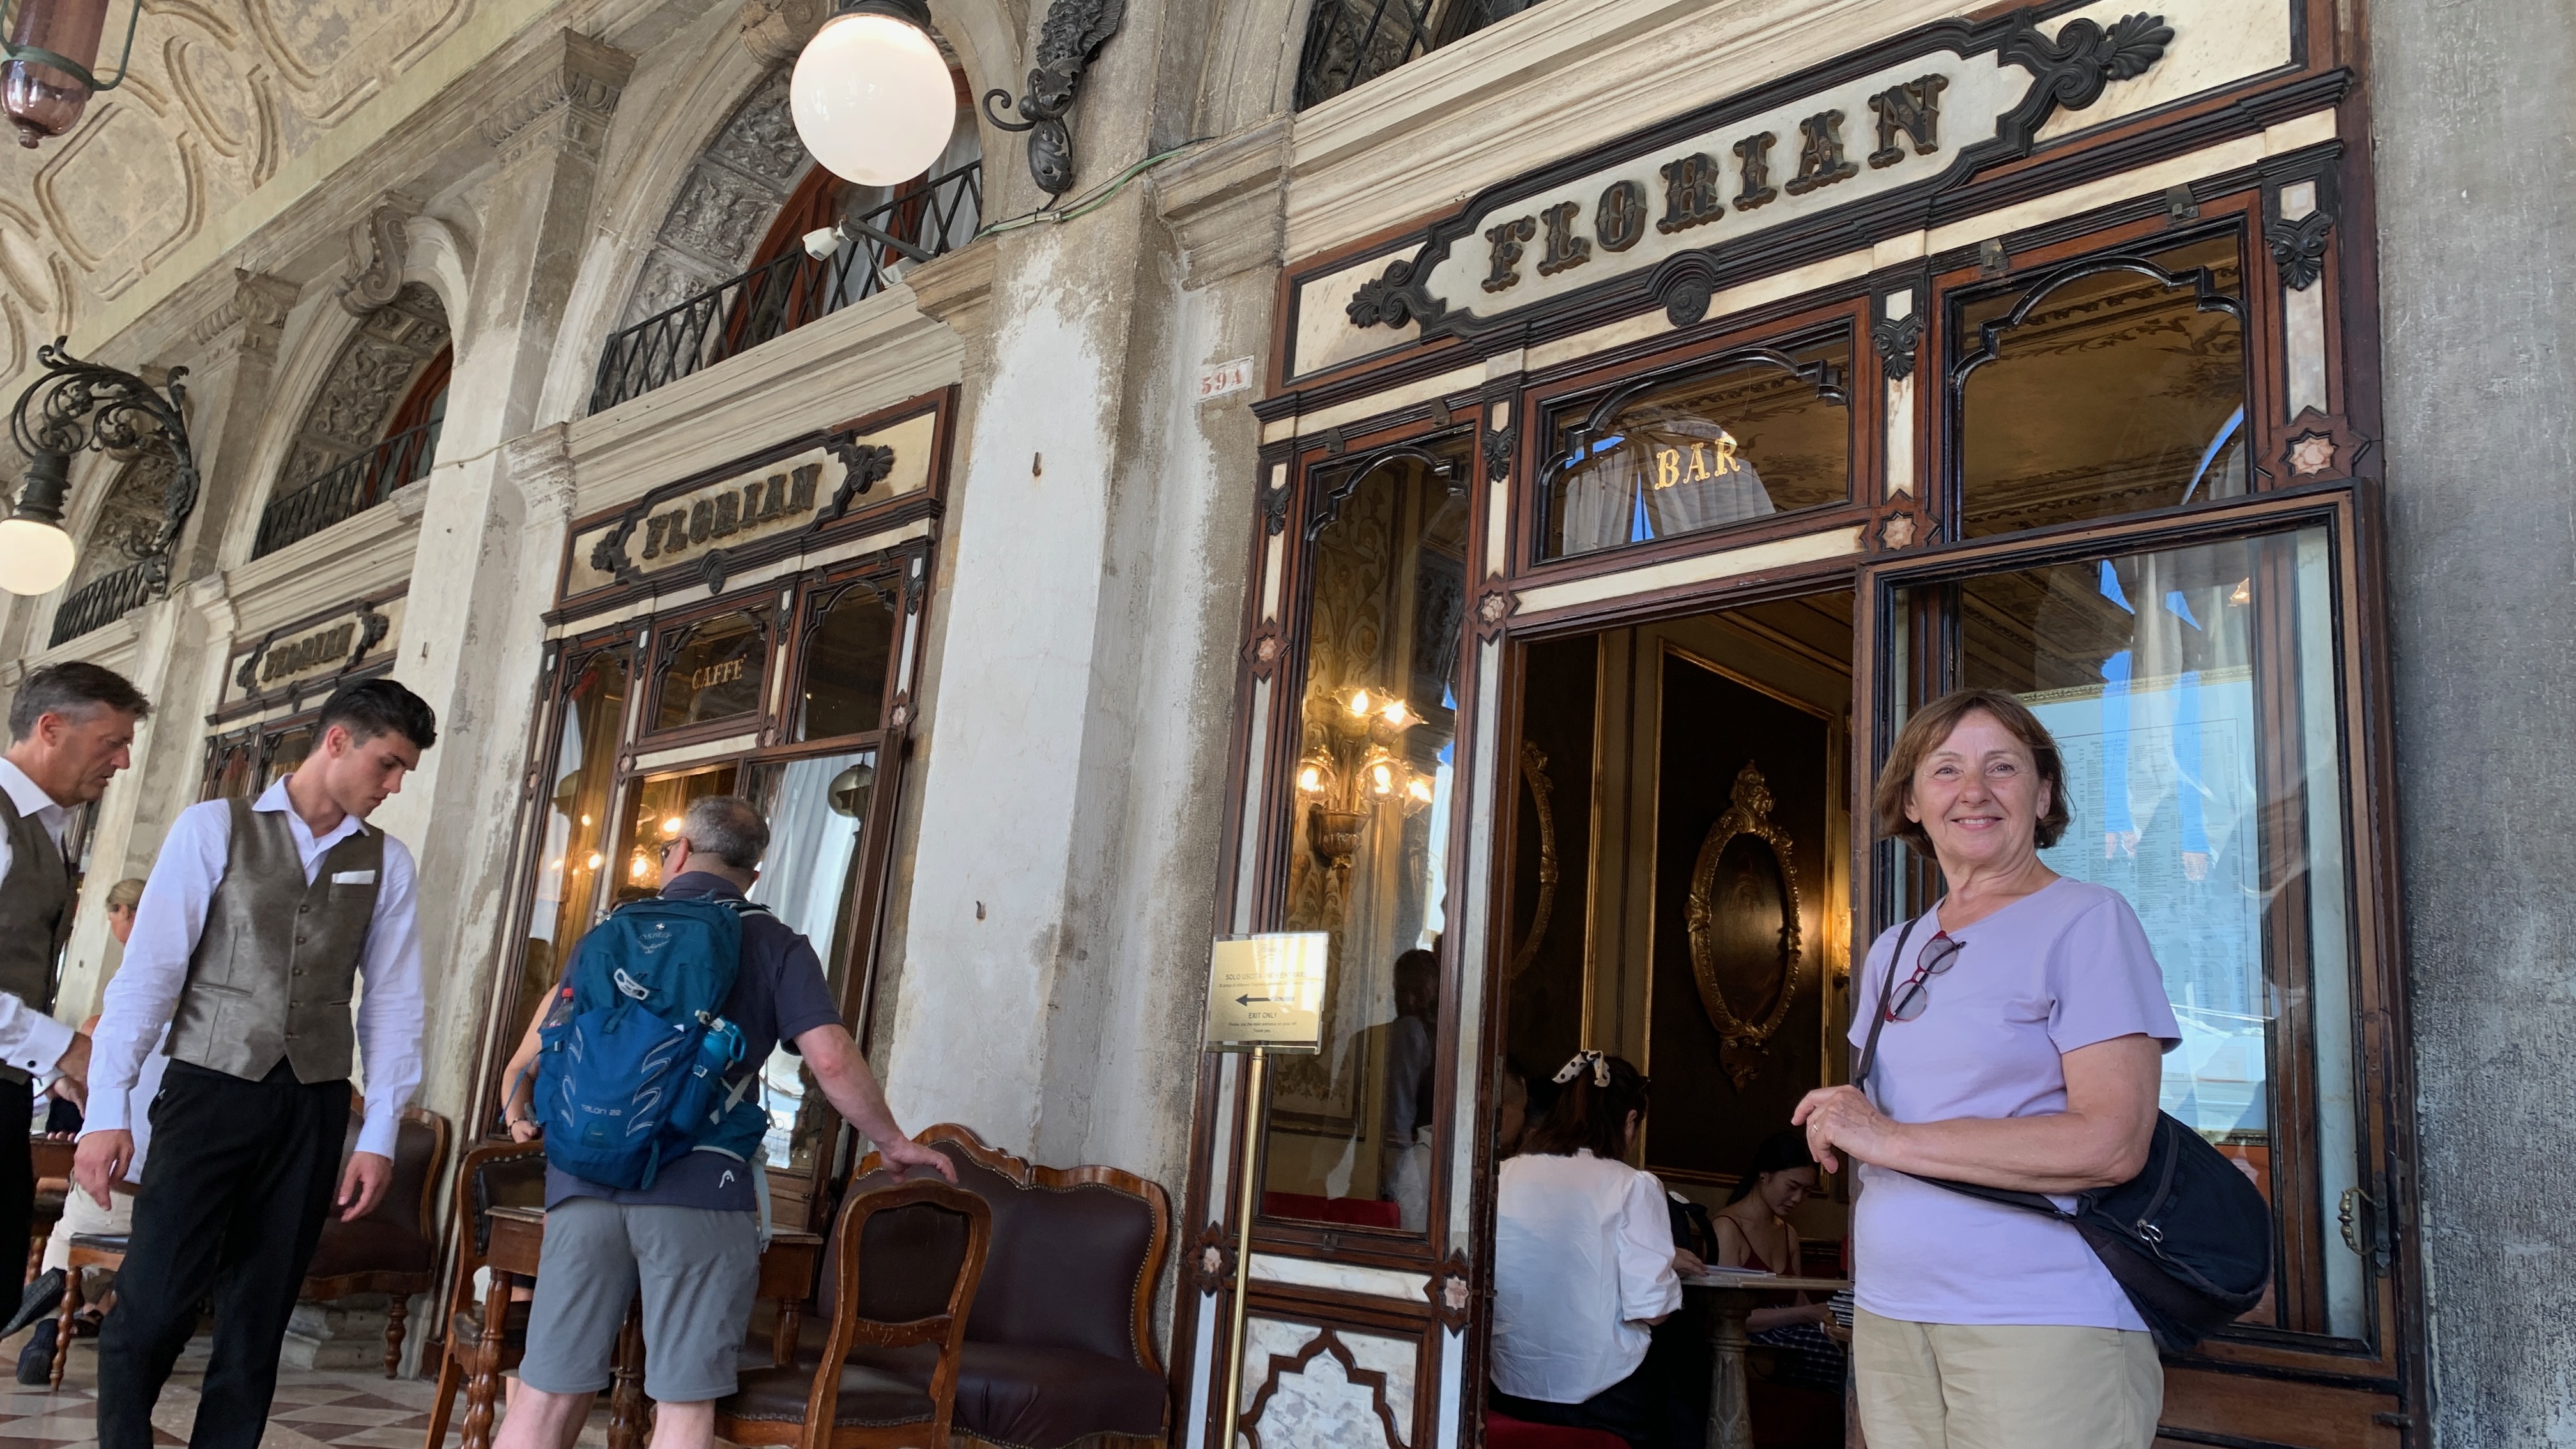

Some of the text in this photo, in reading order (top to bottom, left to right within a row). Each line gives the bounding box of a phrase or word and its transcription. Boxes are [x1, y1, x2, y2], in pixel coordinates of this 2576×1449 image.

[1481, 73, 1949, 294] FLORIAN
[1201, 368, 1243, 395] 59A
[1654, 436, 1740, 491] BAR
[642, 463, 823, 560] FLORIAN
